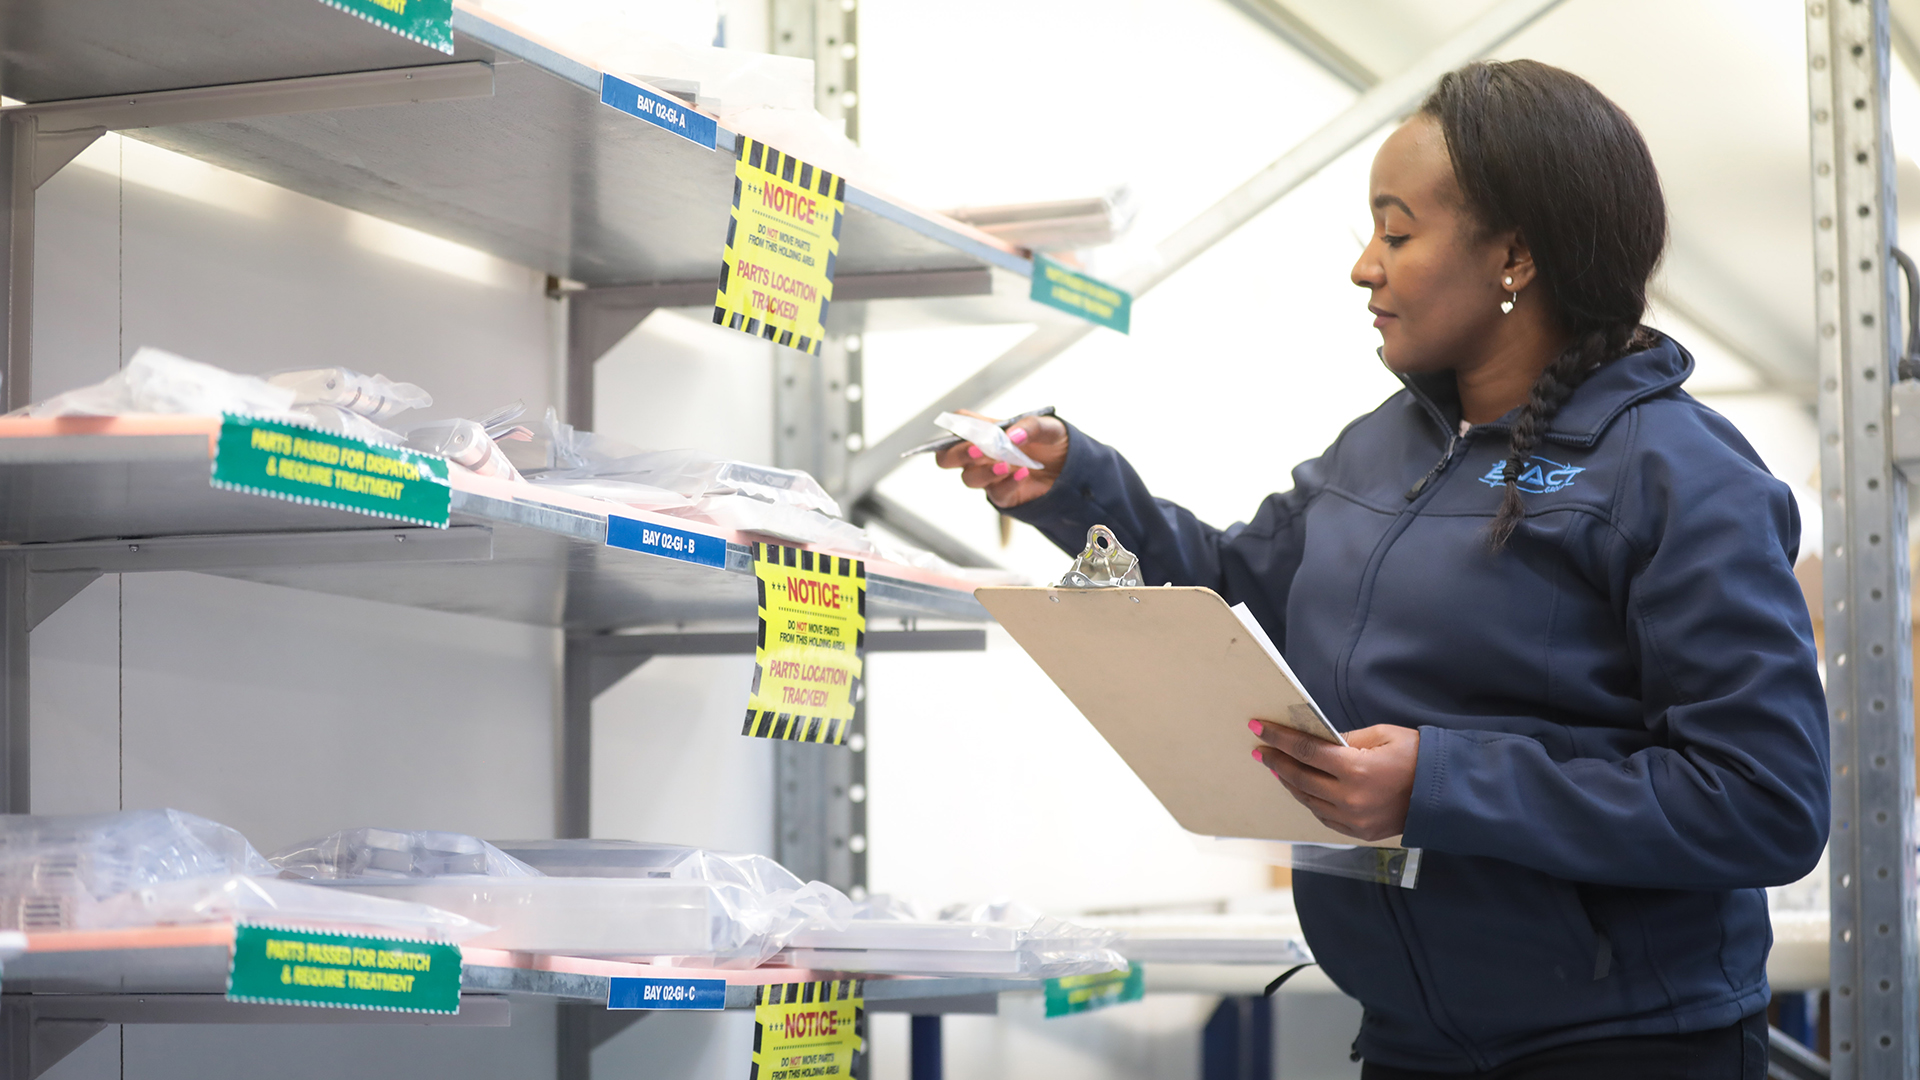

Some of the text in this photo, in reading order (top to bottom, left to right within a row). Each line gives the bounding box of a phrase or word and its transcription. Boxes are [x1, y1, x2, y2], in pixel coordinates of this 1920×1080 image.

[637, 94, 655, 114] BAY
[679, 113, 686, 128] A
[762, 181, 816, 225] NOTICE
[748, 234, 815, 267] FROM THIS HOLDING AREA
[758, 223, 811, 252] DO NOT MOVE PARTS
[736, 259, 817, 303] PARTS LOCATION
[752, 290, 799, 321] TRACKED!
[251, 428, 421, 481] PARTS PASSED FOR DISPATCH
[266, 456, 404, 500] & REQUIRE TREATMENT
[642, 529, 661, 546] BAY
[661, 533, 683, 552] 02-GI
[688, 539, 695, 553] B
[787, 576, 840, 609] NOTICE
[779, 632, 845, 651] FROM THIS HOLDING AREA
[787, 620, 840, 637] DO NOT MOVE PARTS
[769, 659, 848, 686] PARTS LOCATION
[782, 686, 829, 707] TRACKED!
[265, 939, 431, 972] PARTS PASSED FOR DISPATCH
[281, 964, 415, 992] & REQUIRE TREATMENT
[643, 985, 662, 1000] BAY
[662, 985, 684, 1001] 02-GI
[688, 985, 696, 1001] C
[785, 1010, 838, 1039] NOTICE
[771, 1065, 839, 1080] FROM THIS HOLDING AREA
[781, 1053, 835, 1067] DO NOT MOVE PARTS
